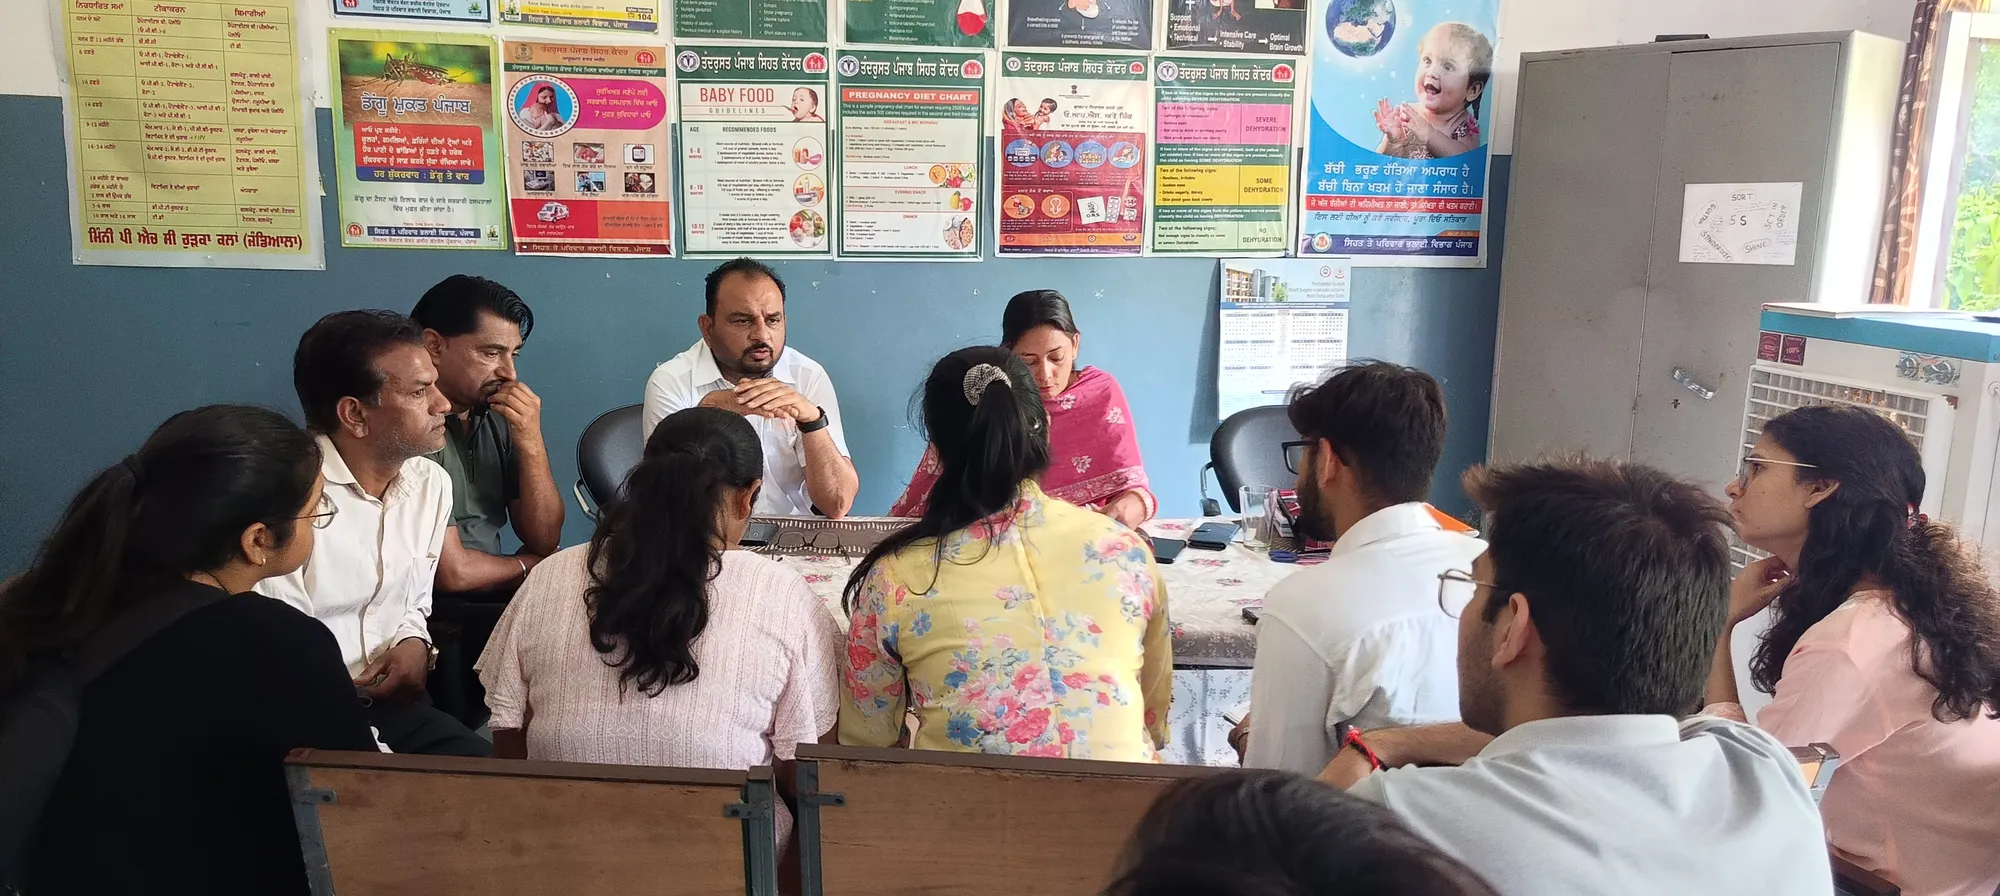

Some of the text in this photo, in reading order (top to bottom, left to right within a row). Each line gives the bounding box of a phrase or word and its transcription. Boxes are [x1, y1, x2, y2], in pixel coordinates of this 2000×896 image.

[1174, 34, 1198, 42] Technical
[1220, 31, 1243, 39] Intensive
[1270, 33, 1290, 41] Optimal
[1224, 41, 1244, 49] Stability
[1284, 44, 1303, 52] Growth
[734, 52, 755, 70] ਪੰਜਾਬ
[893, 57, 913, 76] ਪੰਜਾਬ
[1058, 58, 1079, 73] ਪੰਜਾਬ
[700, 88, 774, 102] BABY FOOD
[433, 95, 471, 113] ਪੰਜਾਬ
[1324, 161, 1345, 174] ਬੱਚੀ
[1318, 178, 1338, 191] ਬੱਚੀ
[1732, 193, 1753, 201] SORT
[1740, 216, 1747, 226] S
[1764, 213, 1774, 229] SET
[120, 228, 132, 244] ਪੀ
